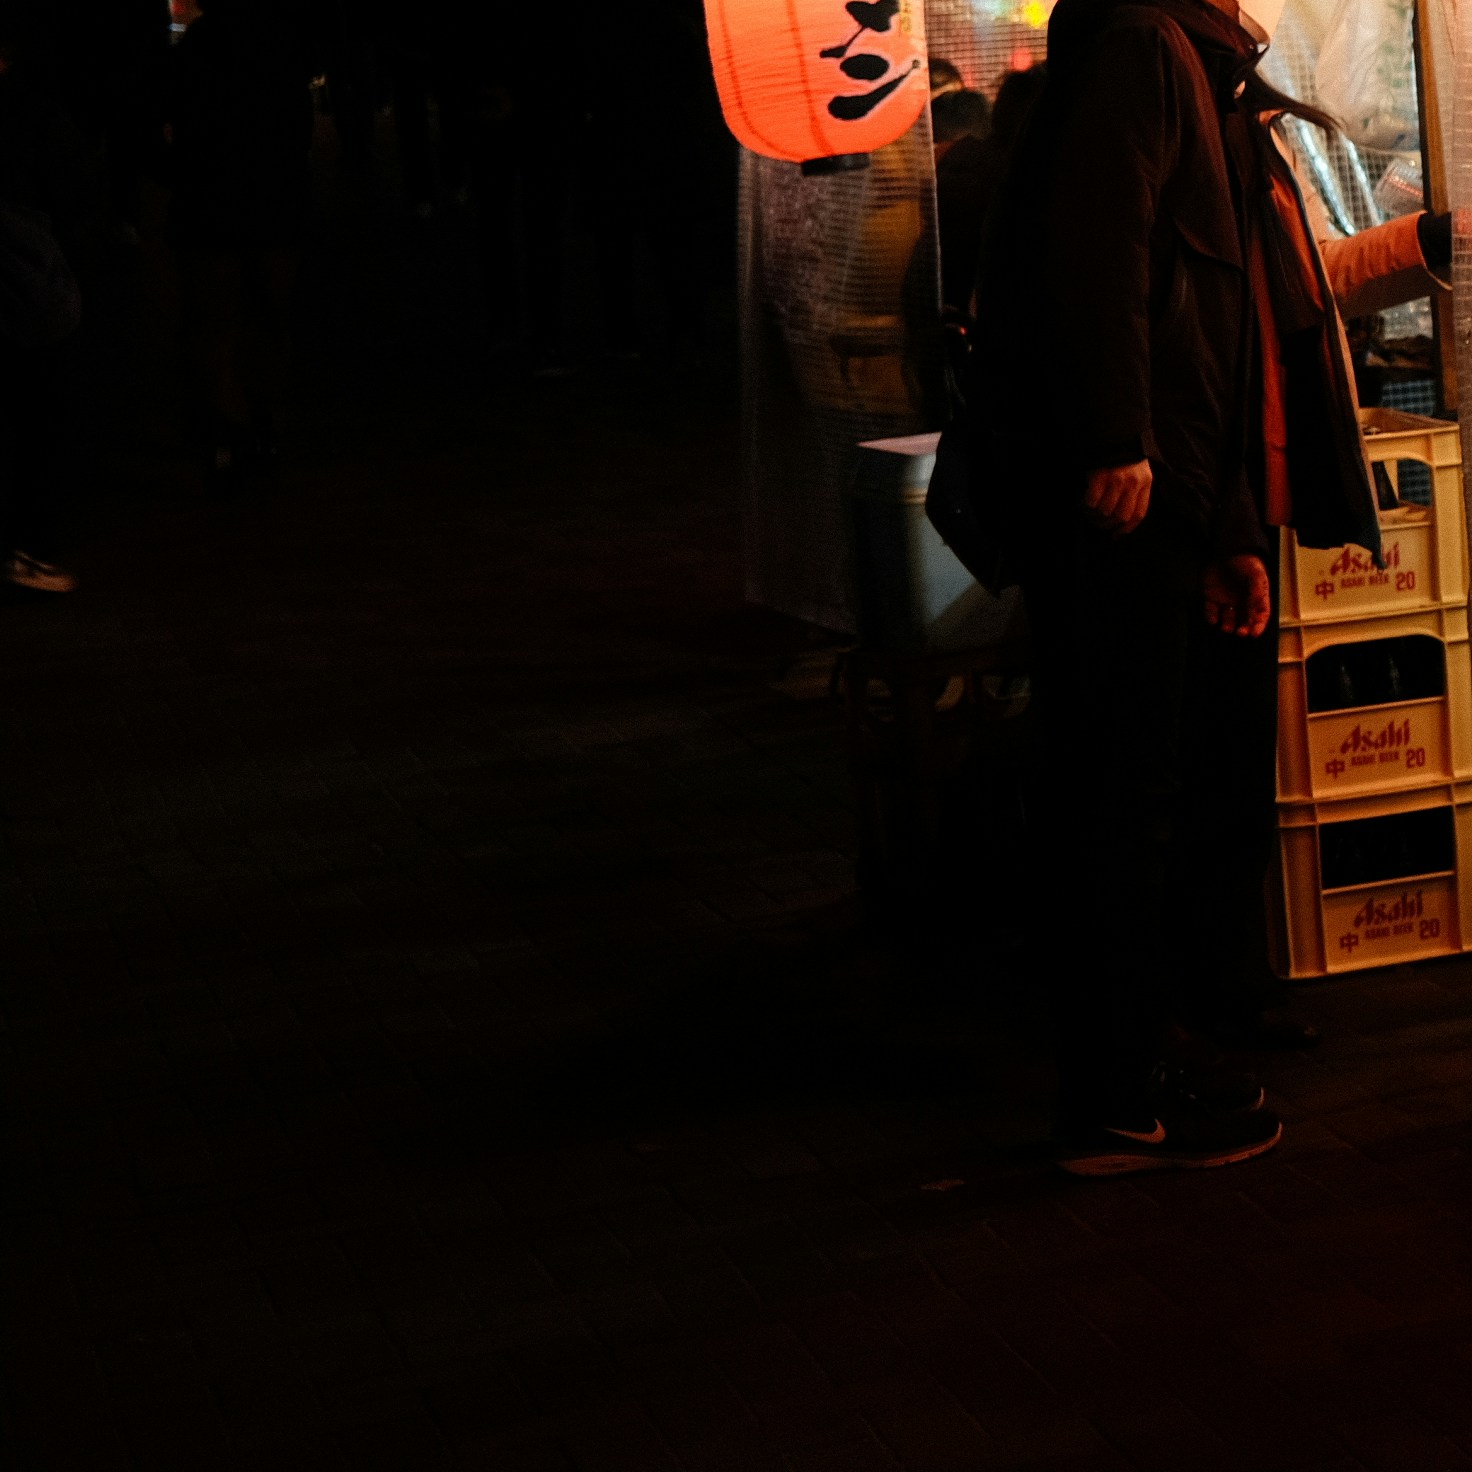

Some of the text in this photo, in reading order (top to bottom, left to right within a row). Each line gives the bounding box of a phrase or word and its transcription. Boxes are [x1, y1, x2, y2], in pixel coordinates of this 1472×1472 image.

[1315, 580, 1335, 602] 中
[1396, 571, 1416, 592] 20
[1340, 718, 1411, 755] Asahi
[1325, 758, 1346, 780] 中
[1406, 747, 1426, 769] 20
[1353, 890, 1424, 929] Asahi
